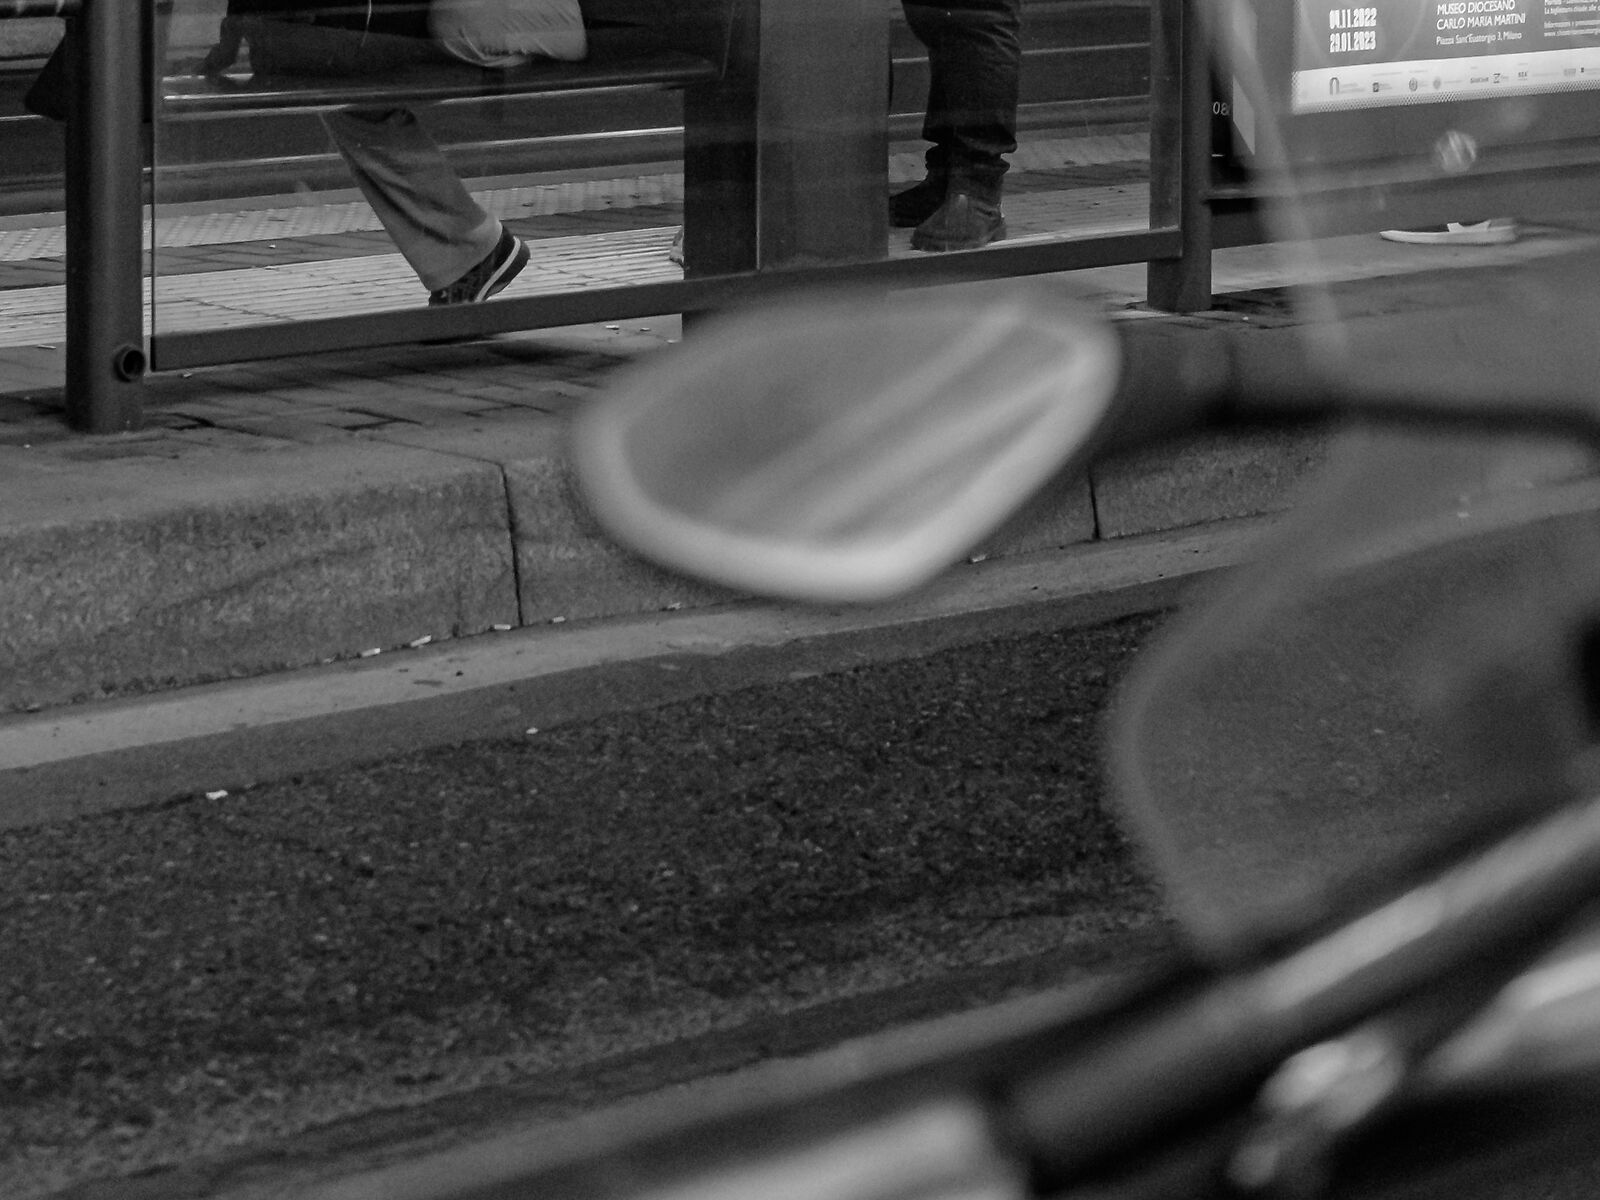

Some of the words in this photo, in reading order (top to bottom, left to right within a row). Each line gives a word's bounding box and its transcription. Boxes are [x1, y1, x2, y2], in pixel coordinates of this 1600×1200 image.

[1437, 3, 1467, 16] MUSEO
[1468, 0, 1516, 14] DIOCESANO
[1436, 17, 1466, 30] CARLO
[1467, 15, 1493, 28] MARIA
[1494, 12, 1526, 25] MARTINI
